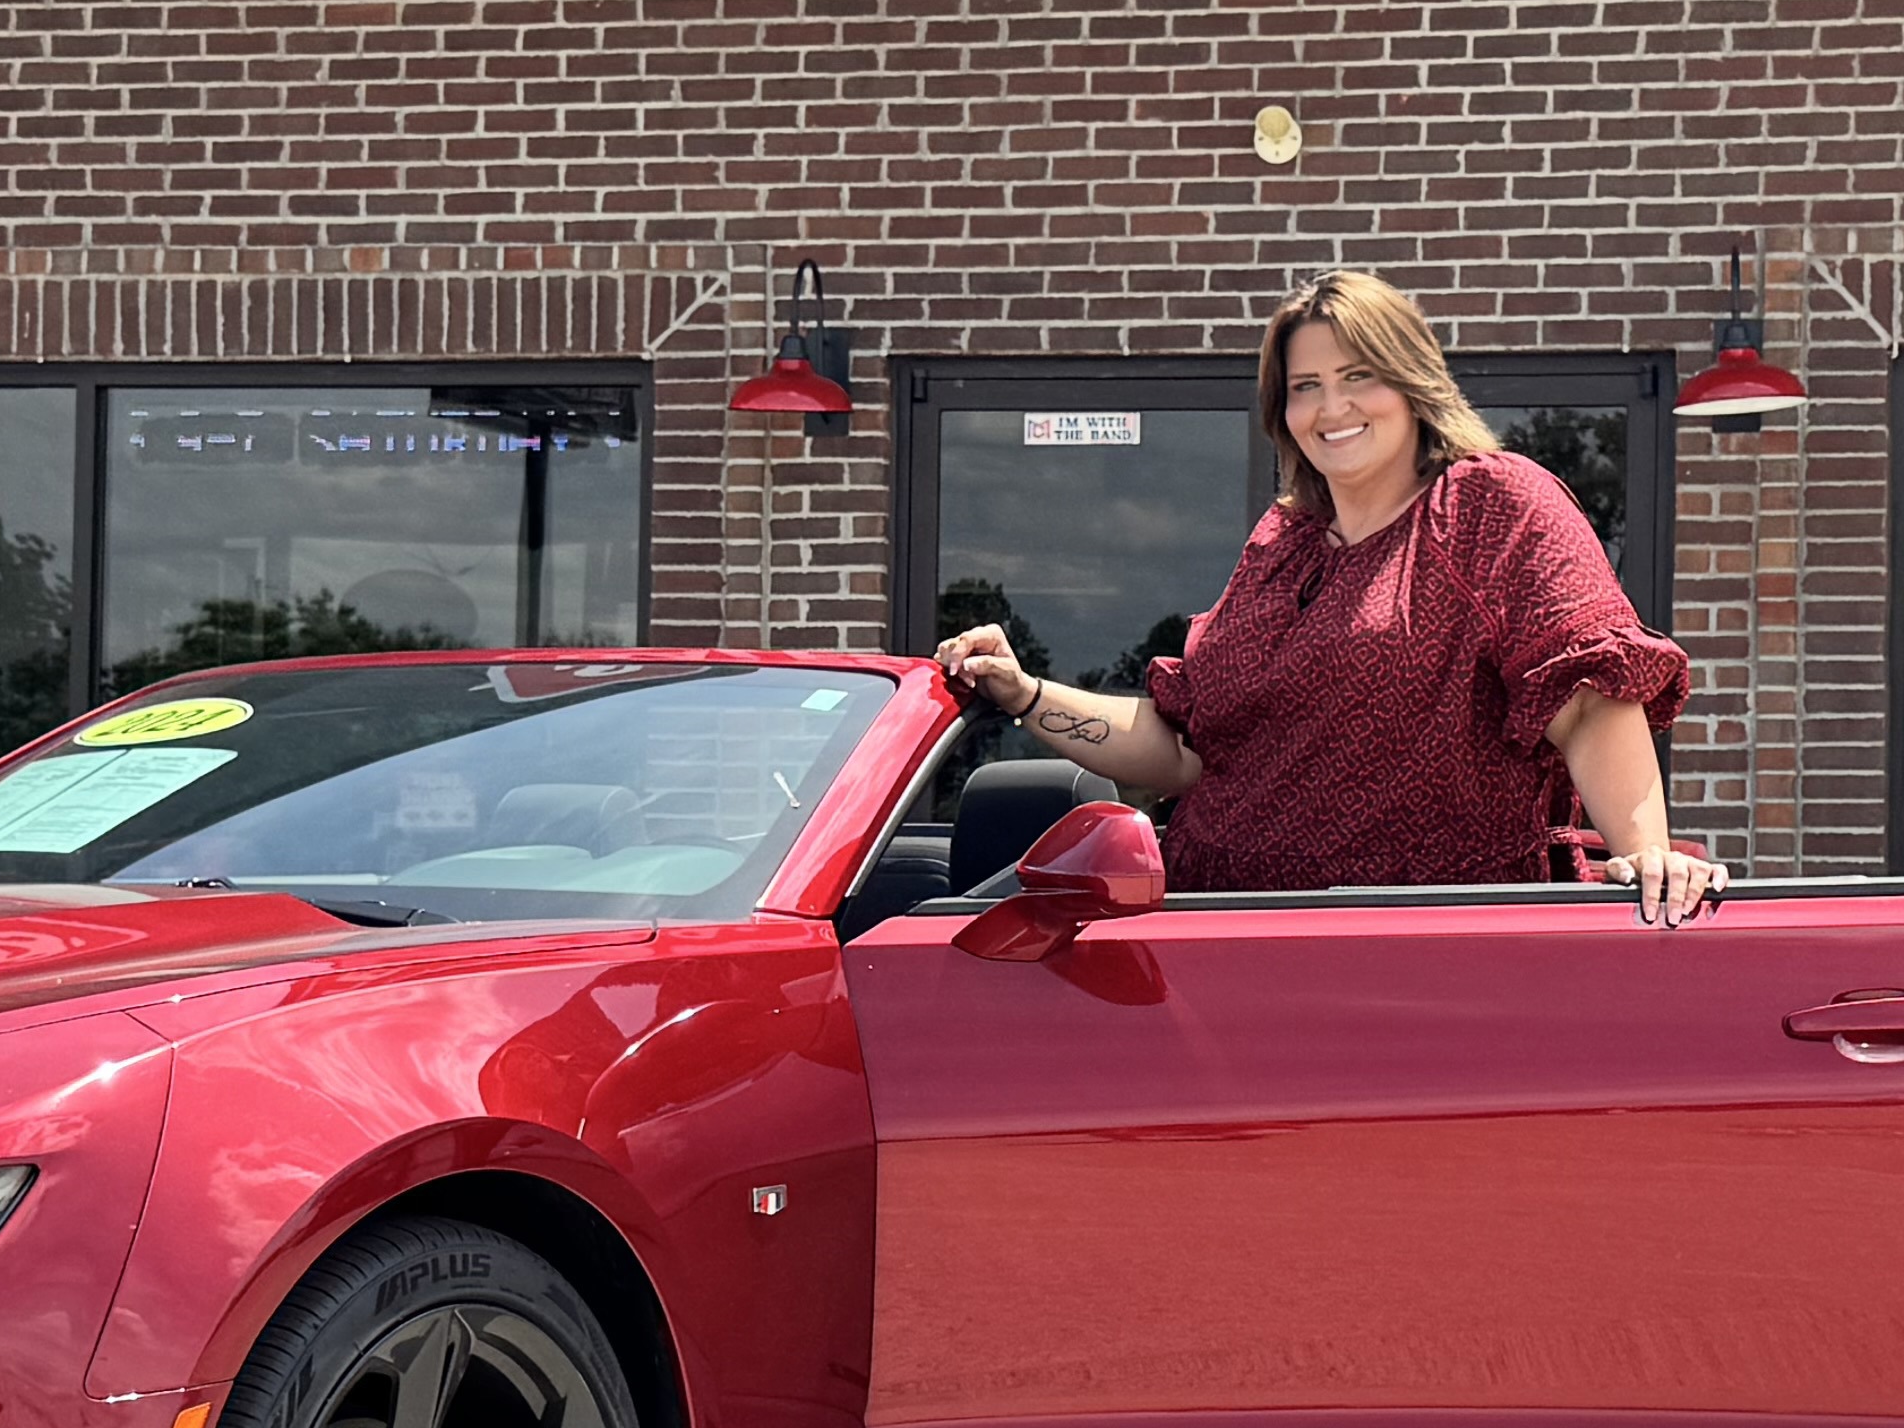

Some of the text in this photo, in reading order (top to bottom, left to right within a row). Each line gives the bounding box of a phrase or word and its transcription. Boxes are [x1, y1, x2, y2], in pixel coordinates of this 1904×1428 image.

[1086, 416, 1127, 428] WITH
[1054, 430, 1132, 440] THE BAND
[94, 708, 235, 738] 2024
